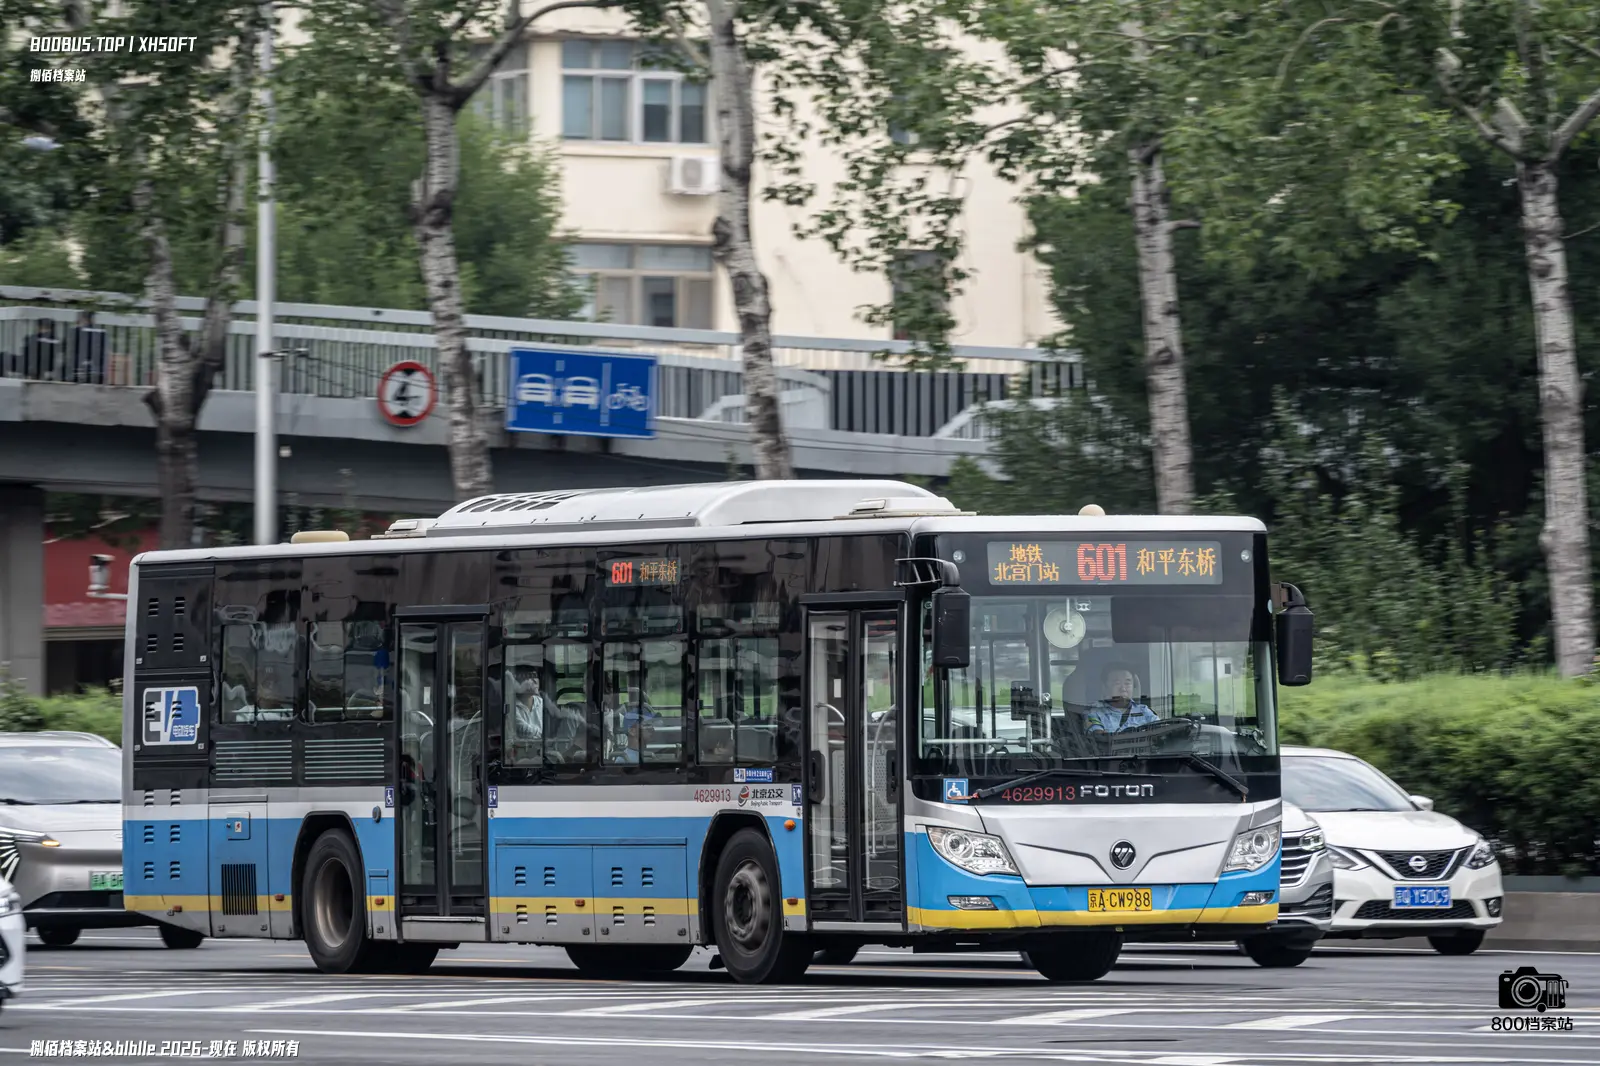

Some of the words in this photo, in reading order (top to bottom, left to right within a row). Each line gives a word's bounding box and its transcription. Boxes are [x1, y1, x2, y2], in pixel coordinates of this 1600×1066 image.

[1009, 543, 1043, 563] 地铁
[1077, 543, 1127, 581] 601
[1136, 548, 1216, 577] 和平东桥
[611, 562, 633, 584] 601
[639, 560, 678, 583] 和平东桥
[994, 563, 1060, 582] 北宫门站
[694, 789, 731, 803] 4629913
[751, 788, 784, 799] 北京公交
[1002, 787, 1076, 802] 4629913
[1080, 784, 1154, 798] FOTON
